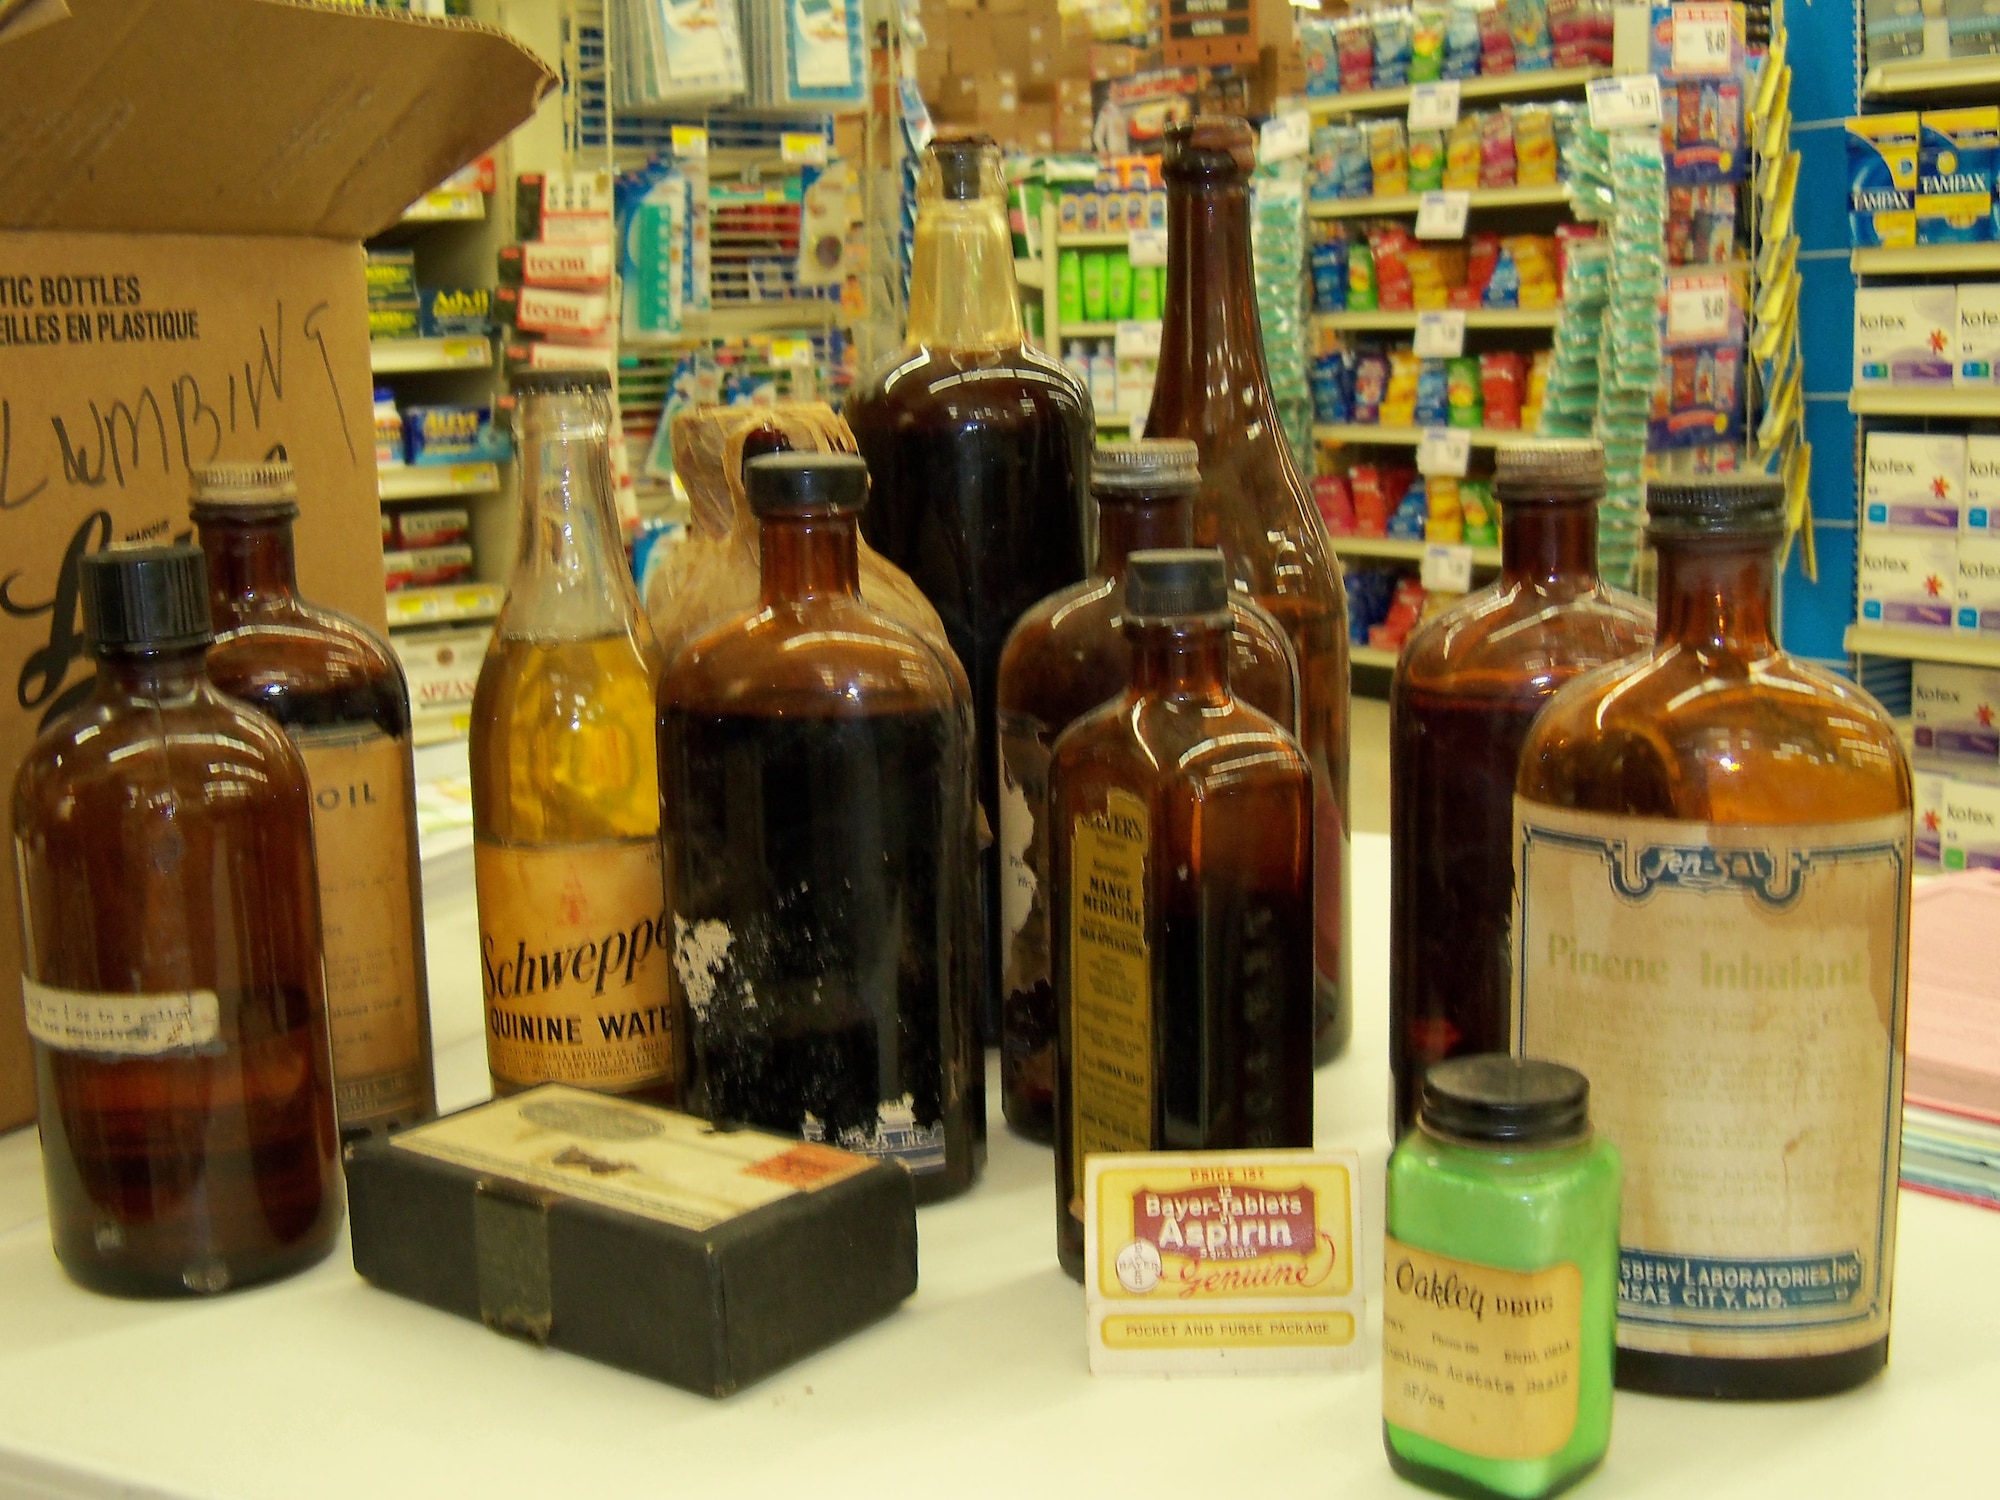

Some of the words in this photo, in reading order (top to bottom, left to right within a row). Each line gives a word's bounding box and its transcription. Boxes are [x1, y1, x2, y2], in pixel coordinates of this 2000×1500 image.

[1922, 173, 1986, 193] TAMPAX
[1852, 192, 1909, 211] TAMPAX
[40, 272, 141, 307] BOTTLES
[66, 313, 93, 343] EN
[98, 309, 200, 342] PLASTIQUE
[316, 782, 376, 811] OIL
[1090, 874, 1132, 902] MANGE
[1083, 892, 1140, 926] MEDICINE
[1549, 933, 1669, 984] Pinene
[490, 1007, 583, 1044] QUININE
[1190, 1167, 1235, 1182] PRICE
[1159, 1218, 1293, 1253] Aspirin
[1178, 1257, 1309, 1299] Genuine
[1396, 1257, 1485, 1324] Oakley
[1496, 1294, 1553, 1318] DRUG
[1126, 1322, 1177, 1338] POCKET
[1184, 1321, 1214, 1337] AND
[1220, 1321, 1264, 1336] PURSE
[1270, 1320, 1330, 1336] PACKAGE
[1447, 1365, 1514, 1395] Acetate
